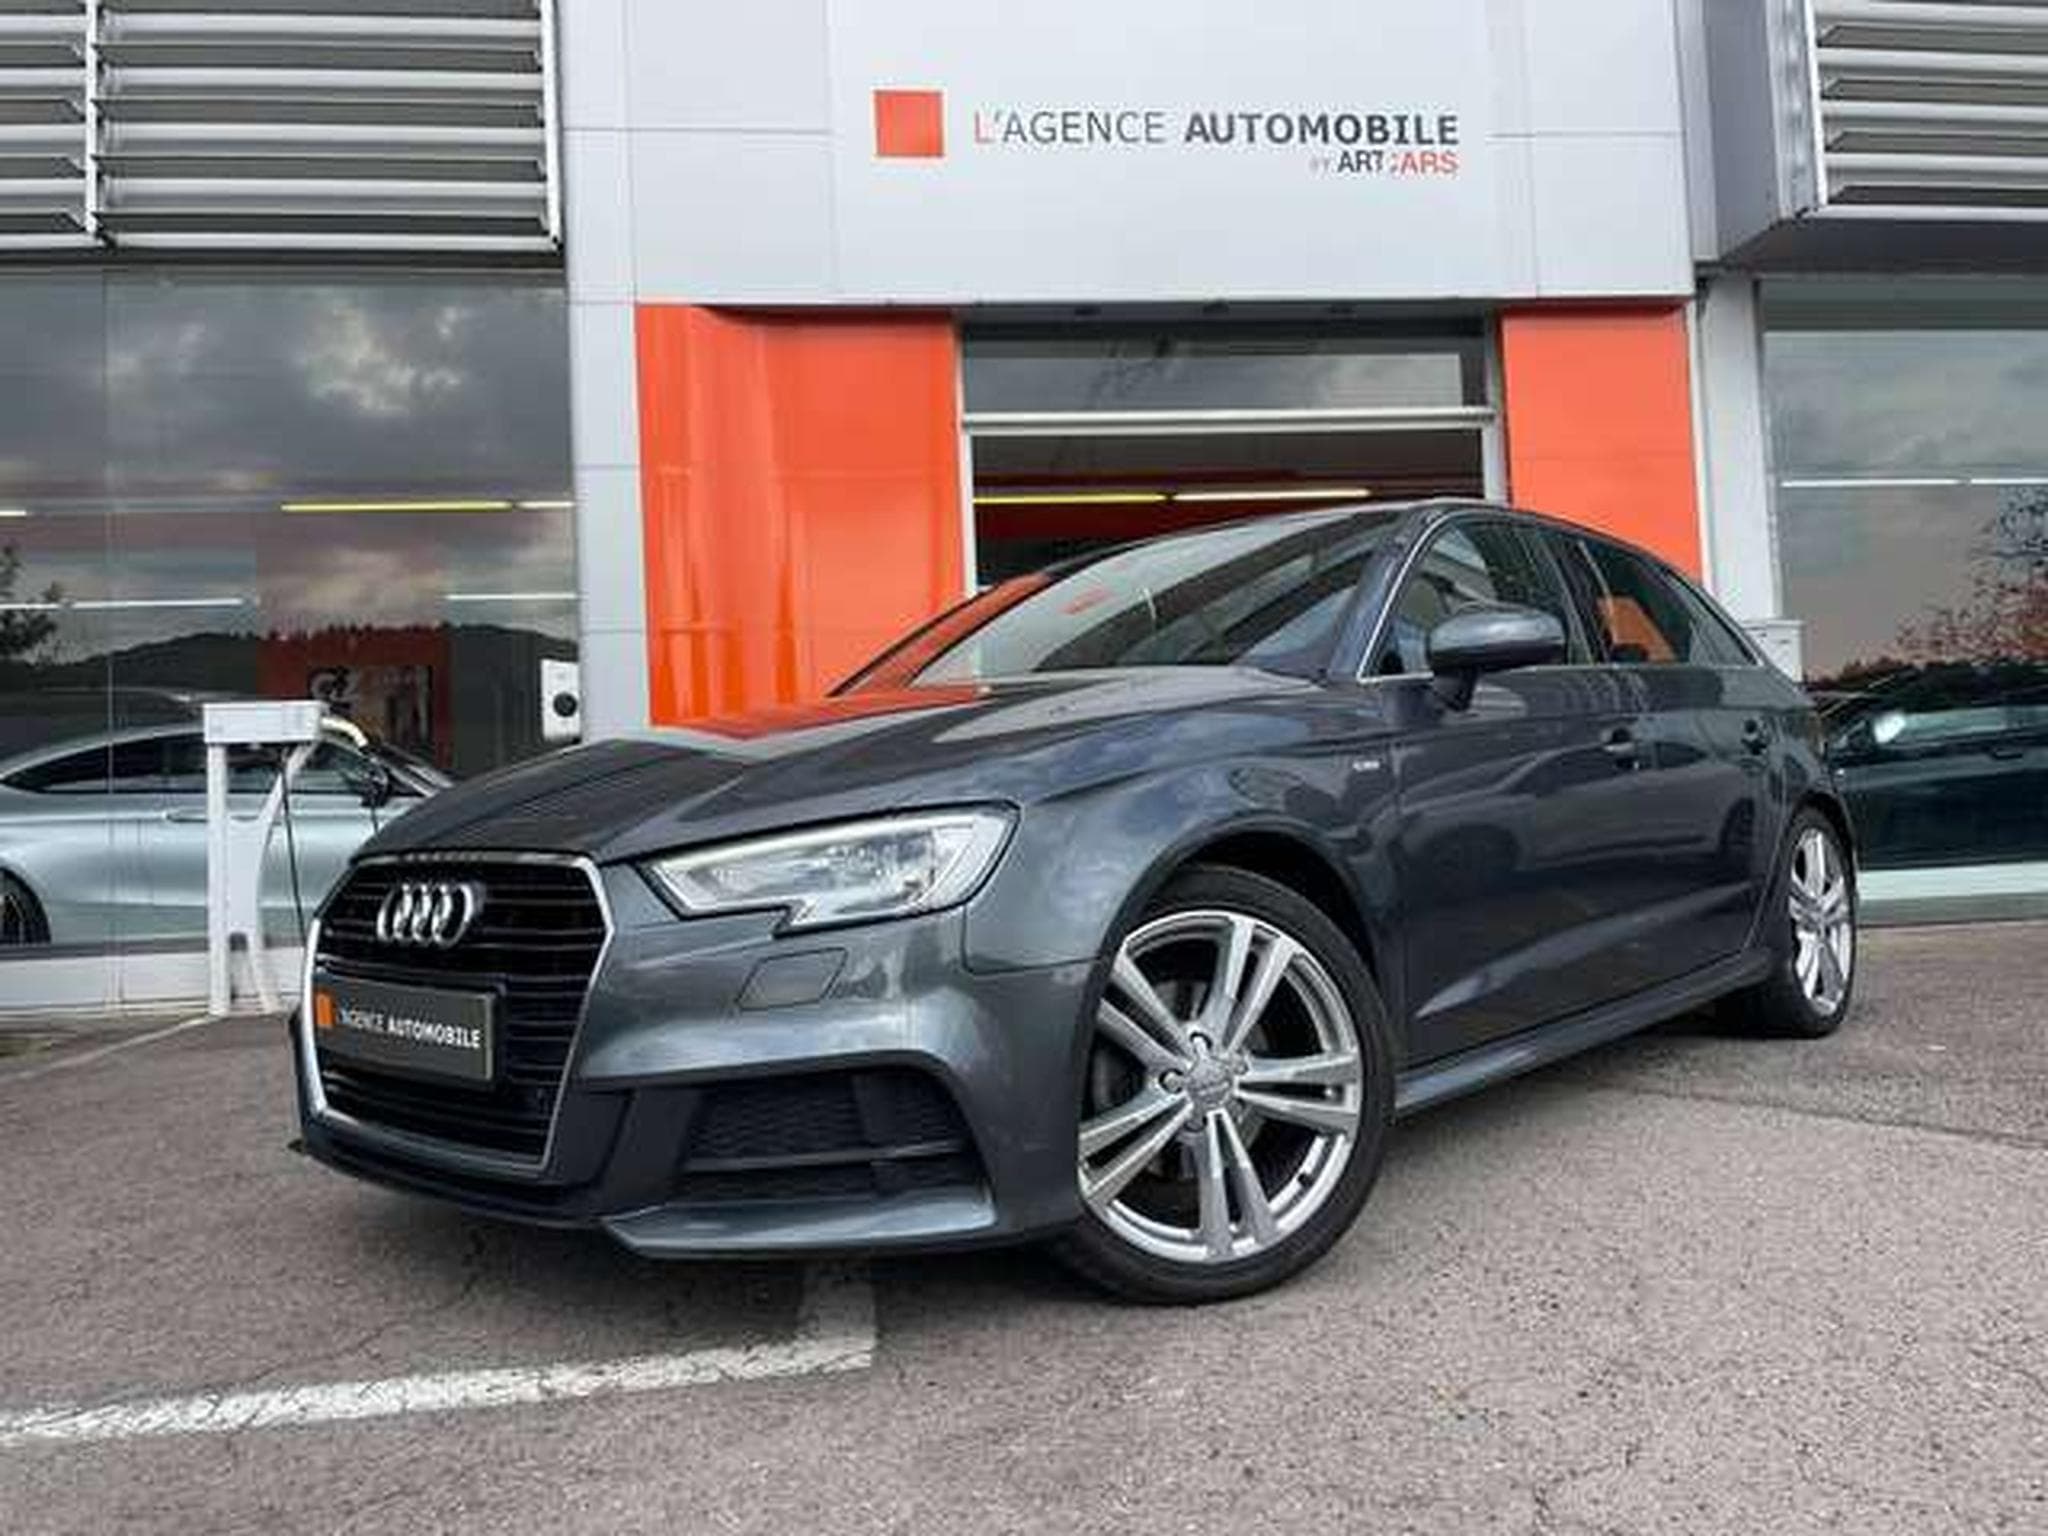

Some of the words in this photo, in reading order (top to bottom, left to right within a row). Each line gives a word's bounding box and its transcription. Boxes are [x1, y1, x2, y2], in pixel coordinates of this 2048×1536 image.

[974, 110, 1165, 144] L'AGENCE
[1184, 112, 1459, 145] AUTOMOBILE
[387, 1014, 481, 1049] AUTOMOBILE
